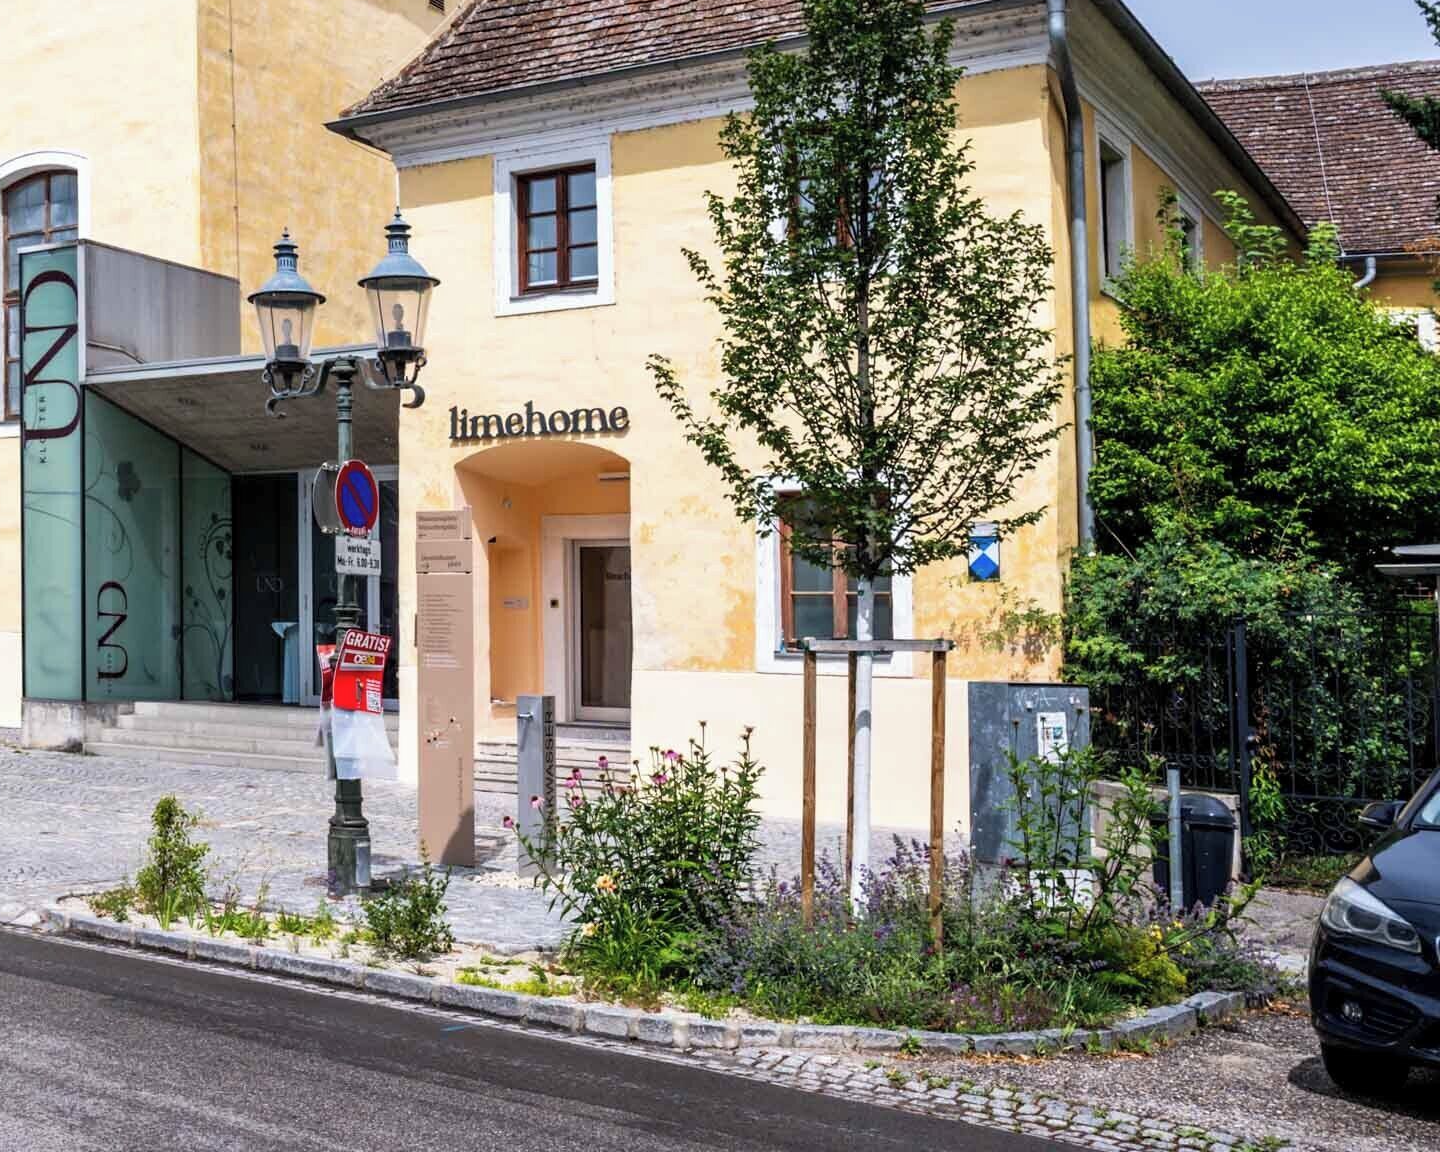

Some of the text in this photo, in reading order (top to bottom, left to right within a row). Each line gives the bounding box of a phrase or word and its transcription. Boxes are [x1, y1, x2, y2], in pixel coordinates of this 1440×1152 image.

[39, 395, 48, 464] KLOTER
[449, 400, 630, 440] limehome
[347, 544, 371, 557] werktags
[346, 631, 391, 652] GRATIS!
